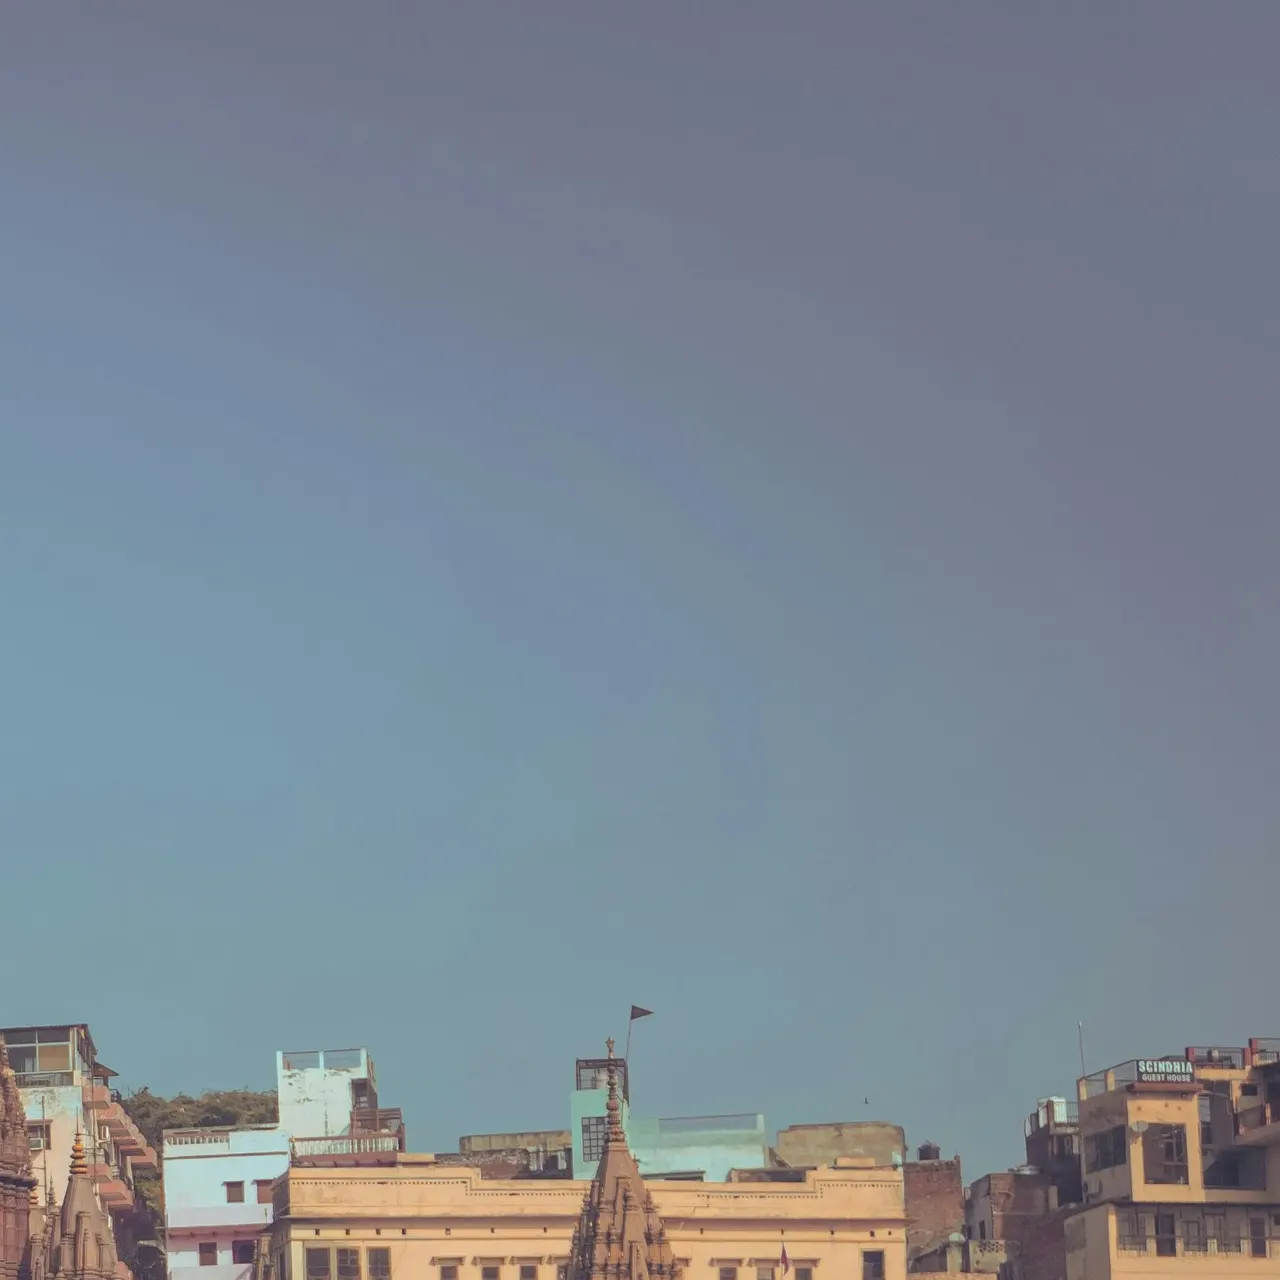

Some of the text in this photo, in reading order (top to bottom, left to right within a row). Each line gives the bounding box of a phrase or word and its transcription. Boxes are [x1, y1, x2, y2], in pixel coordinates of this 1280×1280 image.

[1138, 1060, 1192, 1073] SCINDHIA
[1141, 1073, 1191, 1082] GUEST HOUSE
